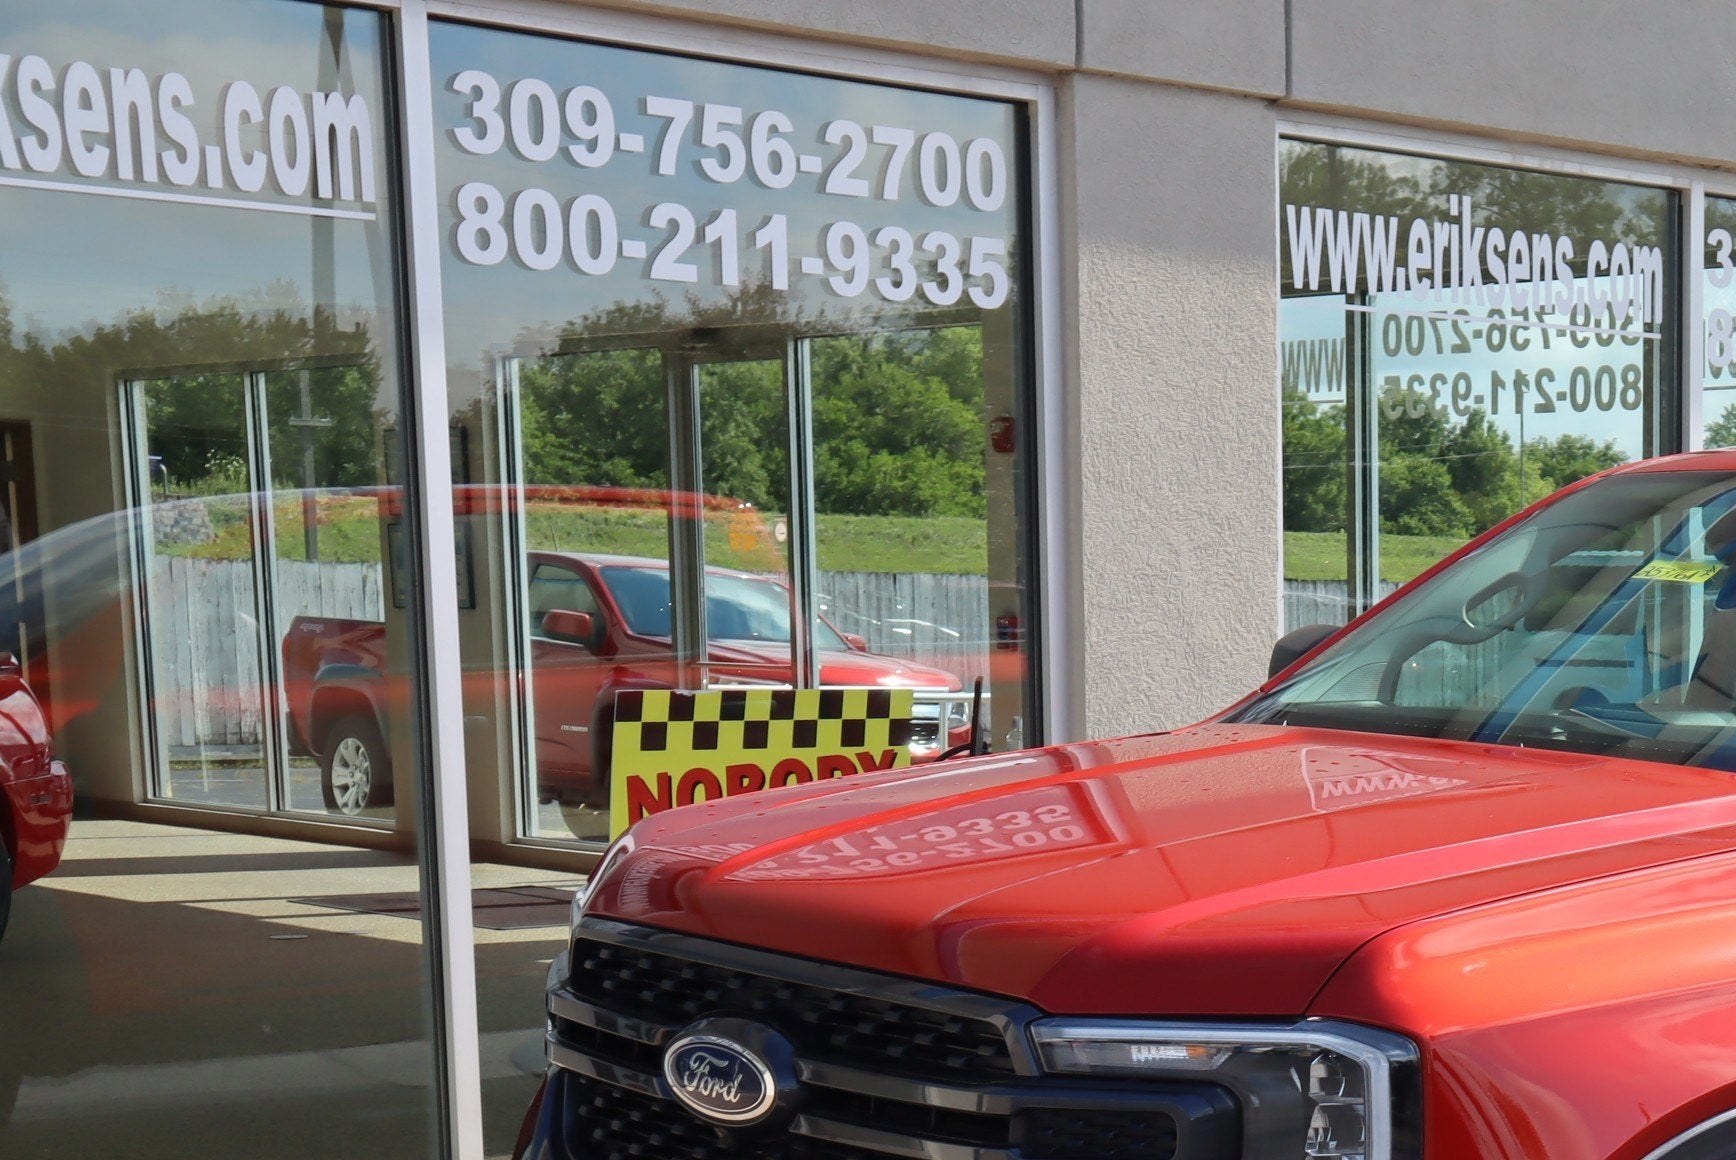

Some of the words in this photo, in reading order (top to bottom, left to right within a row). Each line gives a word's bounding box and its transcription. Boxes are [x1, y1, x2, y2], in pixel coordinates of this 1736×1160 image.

[452, 70, 1006, 212] 309-756-2700
[456, 182, 1008, 310] 800-211-9335
[1286, 194, 1663, 325] www.eriksens.com
[683, 1050, 742, 1104] Ford
